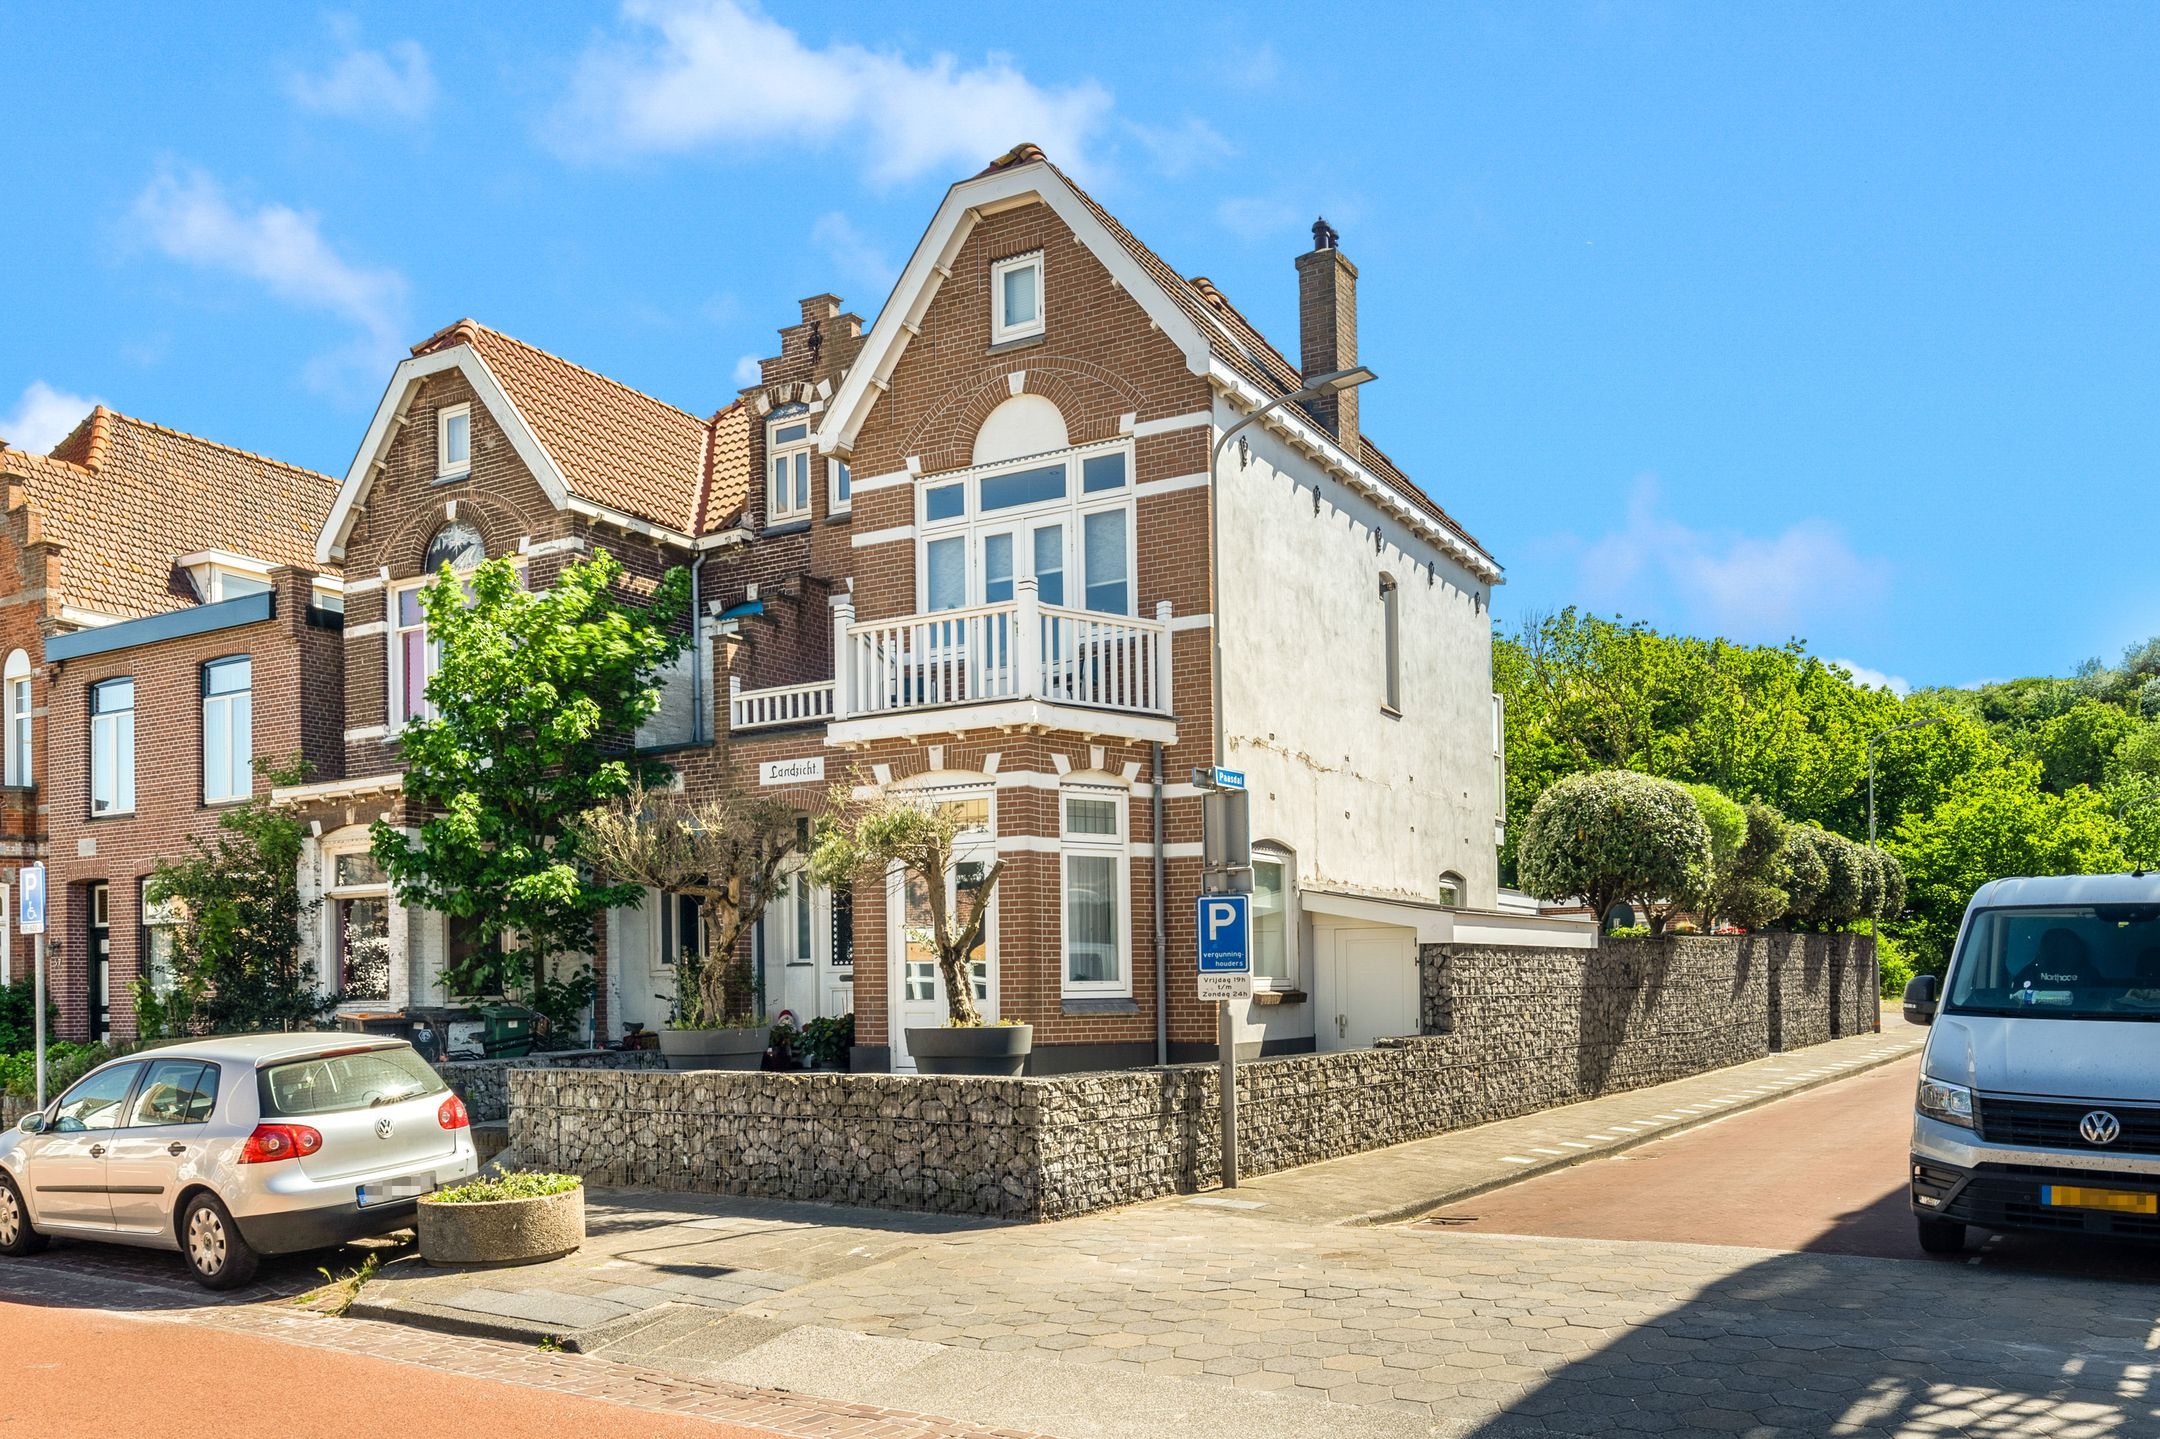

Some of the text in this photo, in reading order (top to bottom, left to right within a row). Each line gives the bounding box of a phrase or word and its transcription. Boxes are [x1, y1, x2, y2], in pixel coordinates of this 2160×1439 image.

[1219, 771, 1243, 785] Paasdal
[25, 873, 37, 900] P
[1209, 903, 1236, 940] P
